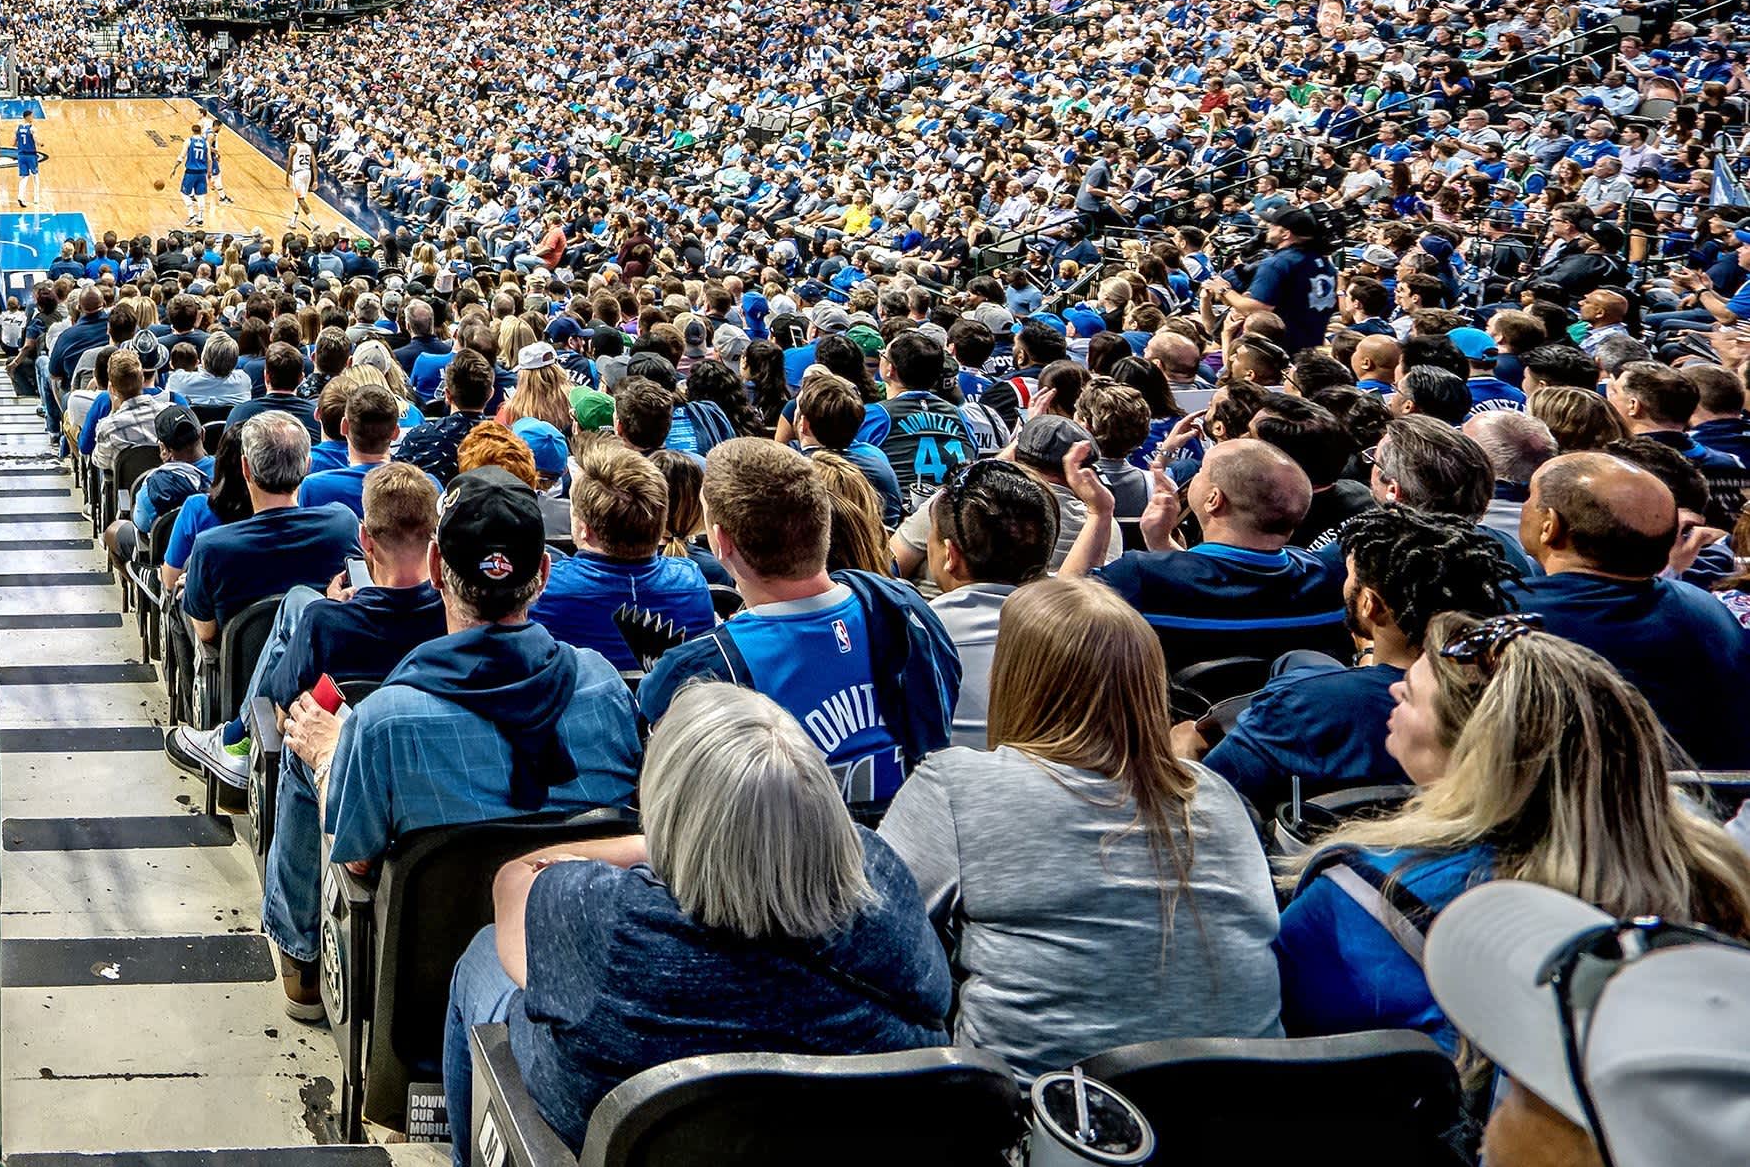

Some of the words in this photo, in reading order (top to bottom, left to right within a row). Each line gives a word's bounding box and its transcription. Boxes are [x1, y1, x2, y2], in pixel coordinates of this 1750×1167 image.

[193, 147, 204, 160] 77
[299, 154, 310, 165] 25
[898, 411, 960, 435] NOWITZKI
[914, 437, 966, 484] 41
[805, 683, 887, 753] OWIT
[411, 1095, 446, 1108] DOWN
[411, 1109, 435, 1122] OUR
[410, 1122, 450, 1135] MOBILE
